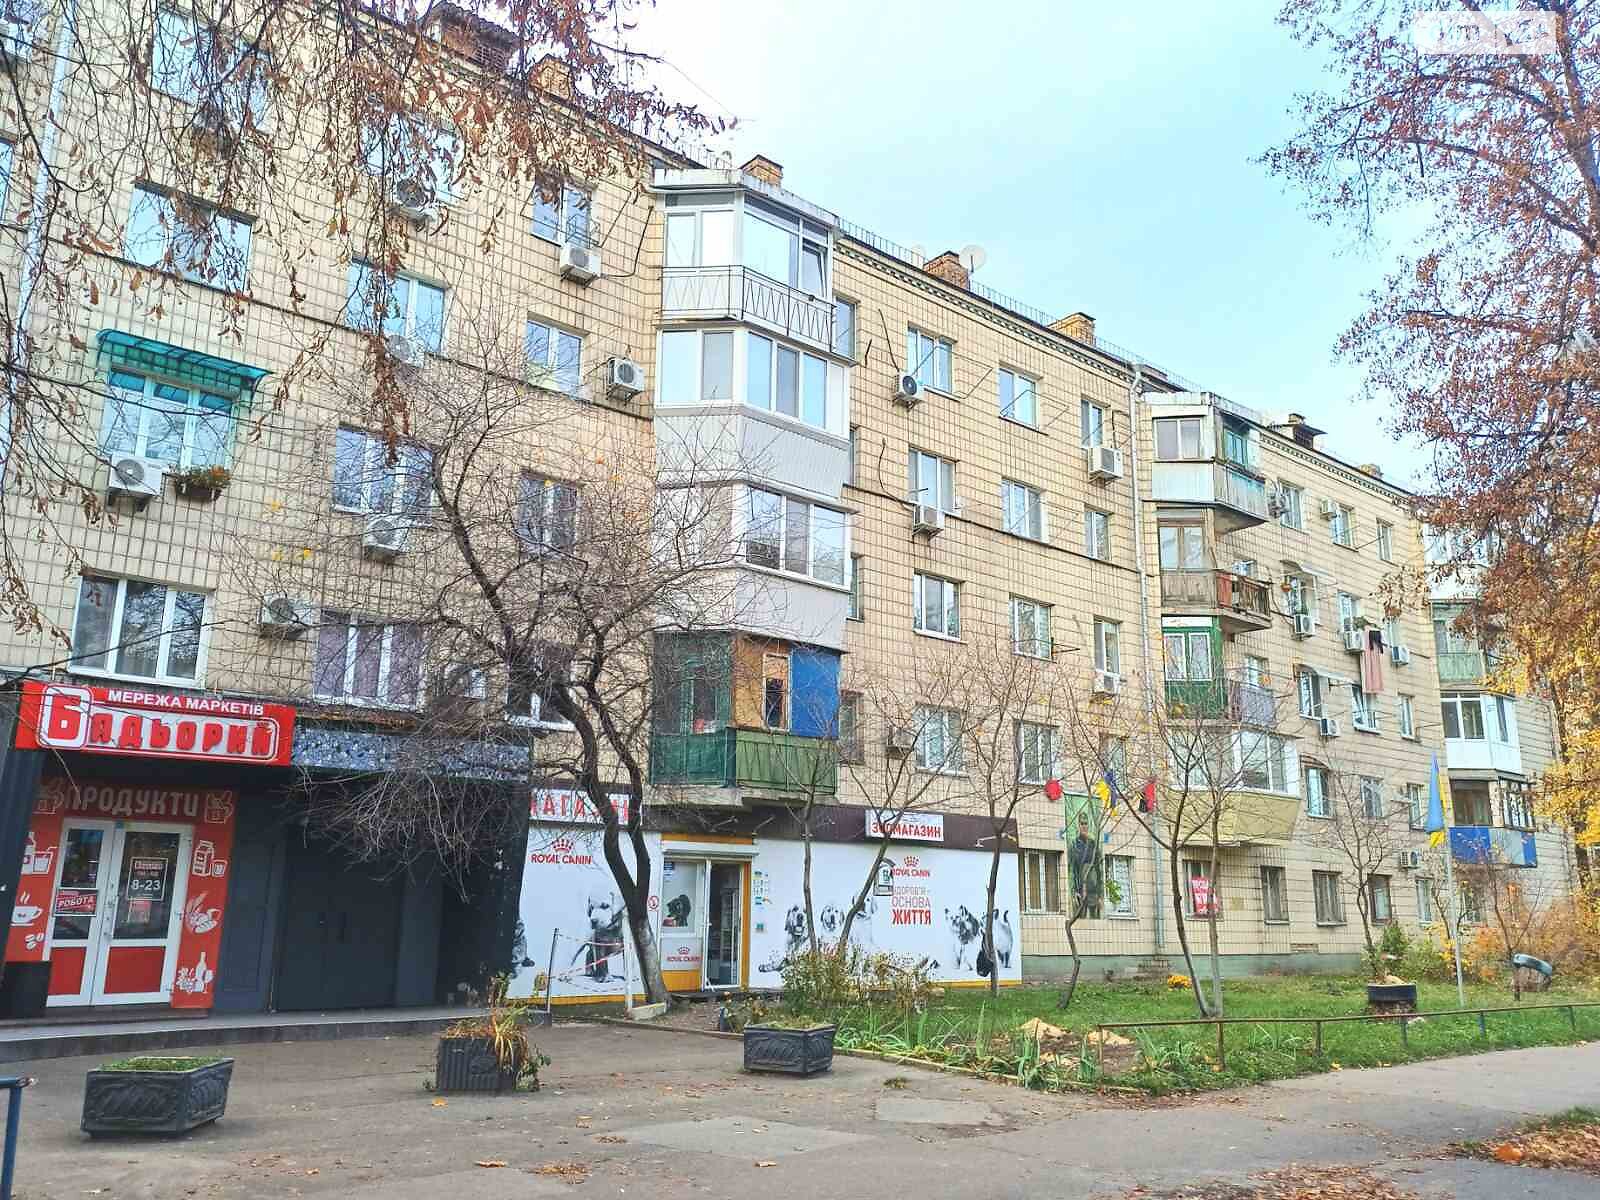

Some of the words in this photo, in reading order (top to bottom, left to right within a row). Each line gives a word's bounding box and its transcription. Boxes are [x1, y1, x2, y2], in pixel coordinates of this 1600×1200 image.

[108, 689, 182, 709] МЕРЕЖА
[185, 700, 265, 717] МАРКЕТІВ
[64, 786, 199, 817] ПРОДУКТИ
[531, 854, 560, 864] ROYAL
[562, 855, 592, 865] CANIN
[131, 879, 161, 891] 8-23
[892, 896, 931, 908] ОСНОВА
[892, 909, 932, 925] ЖИТТЯ
